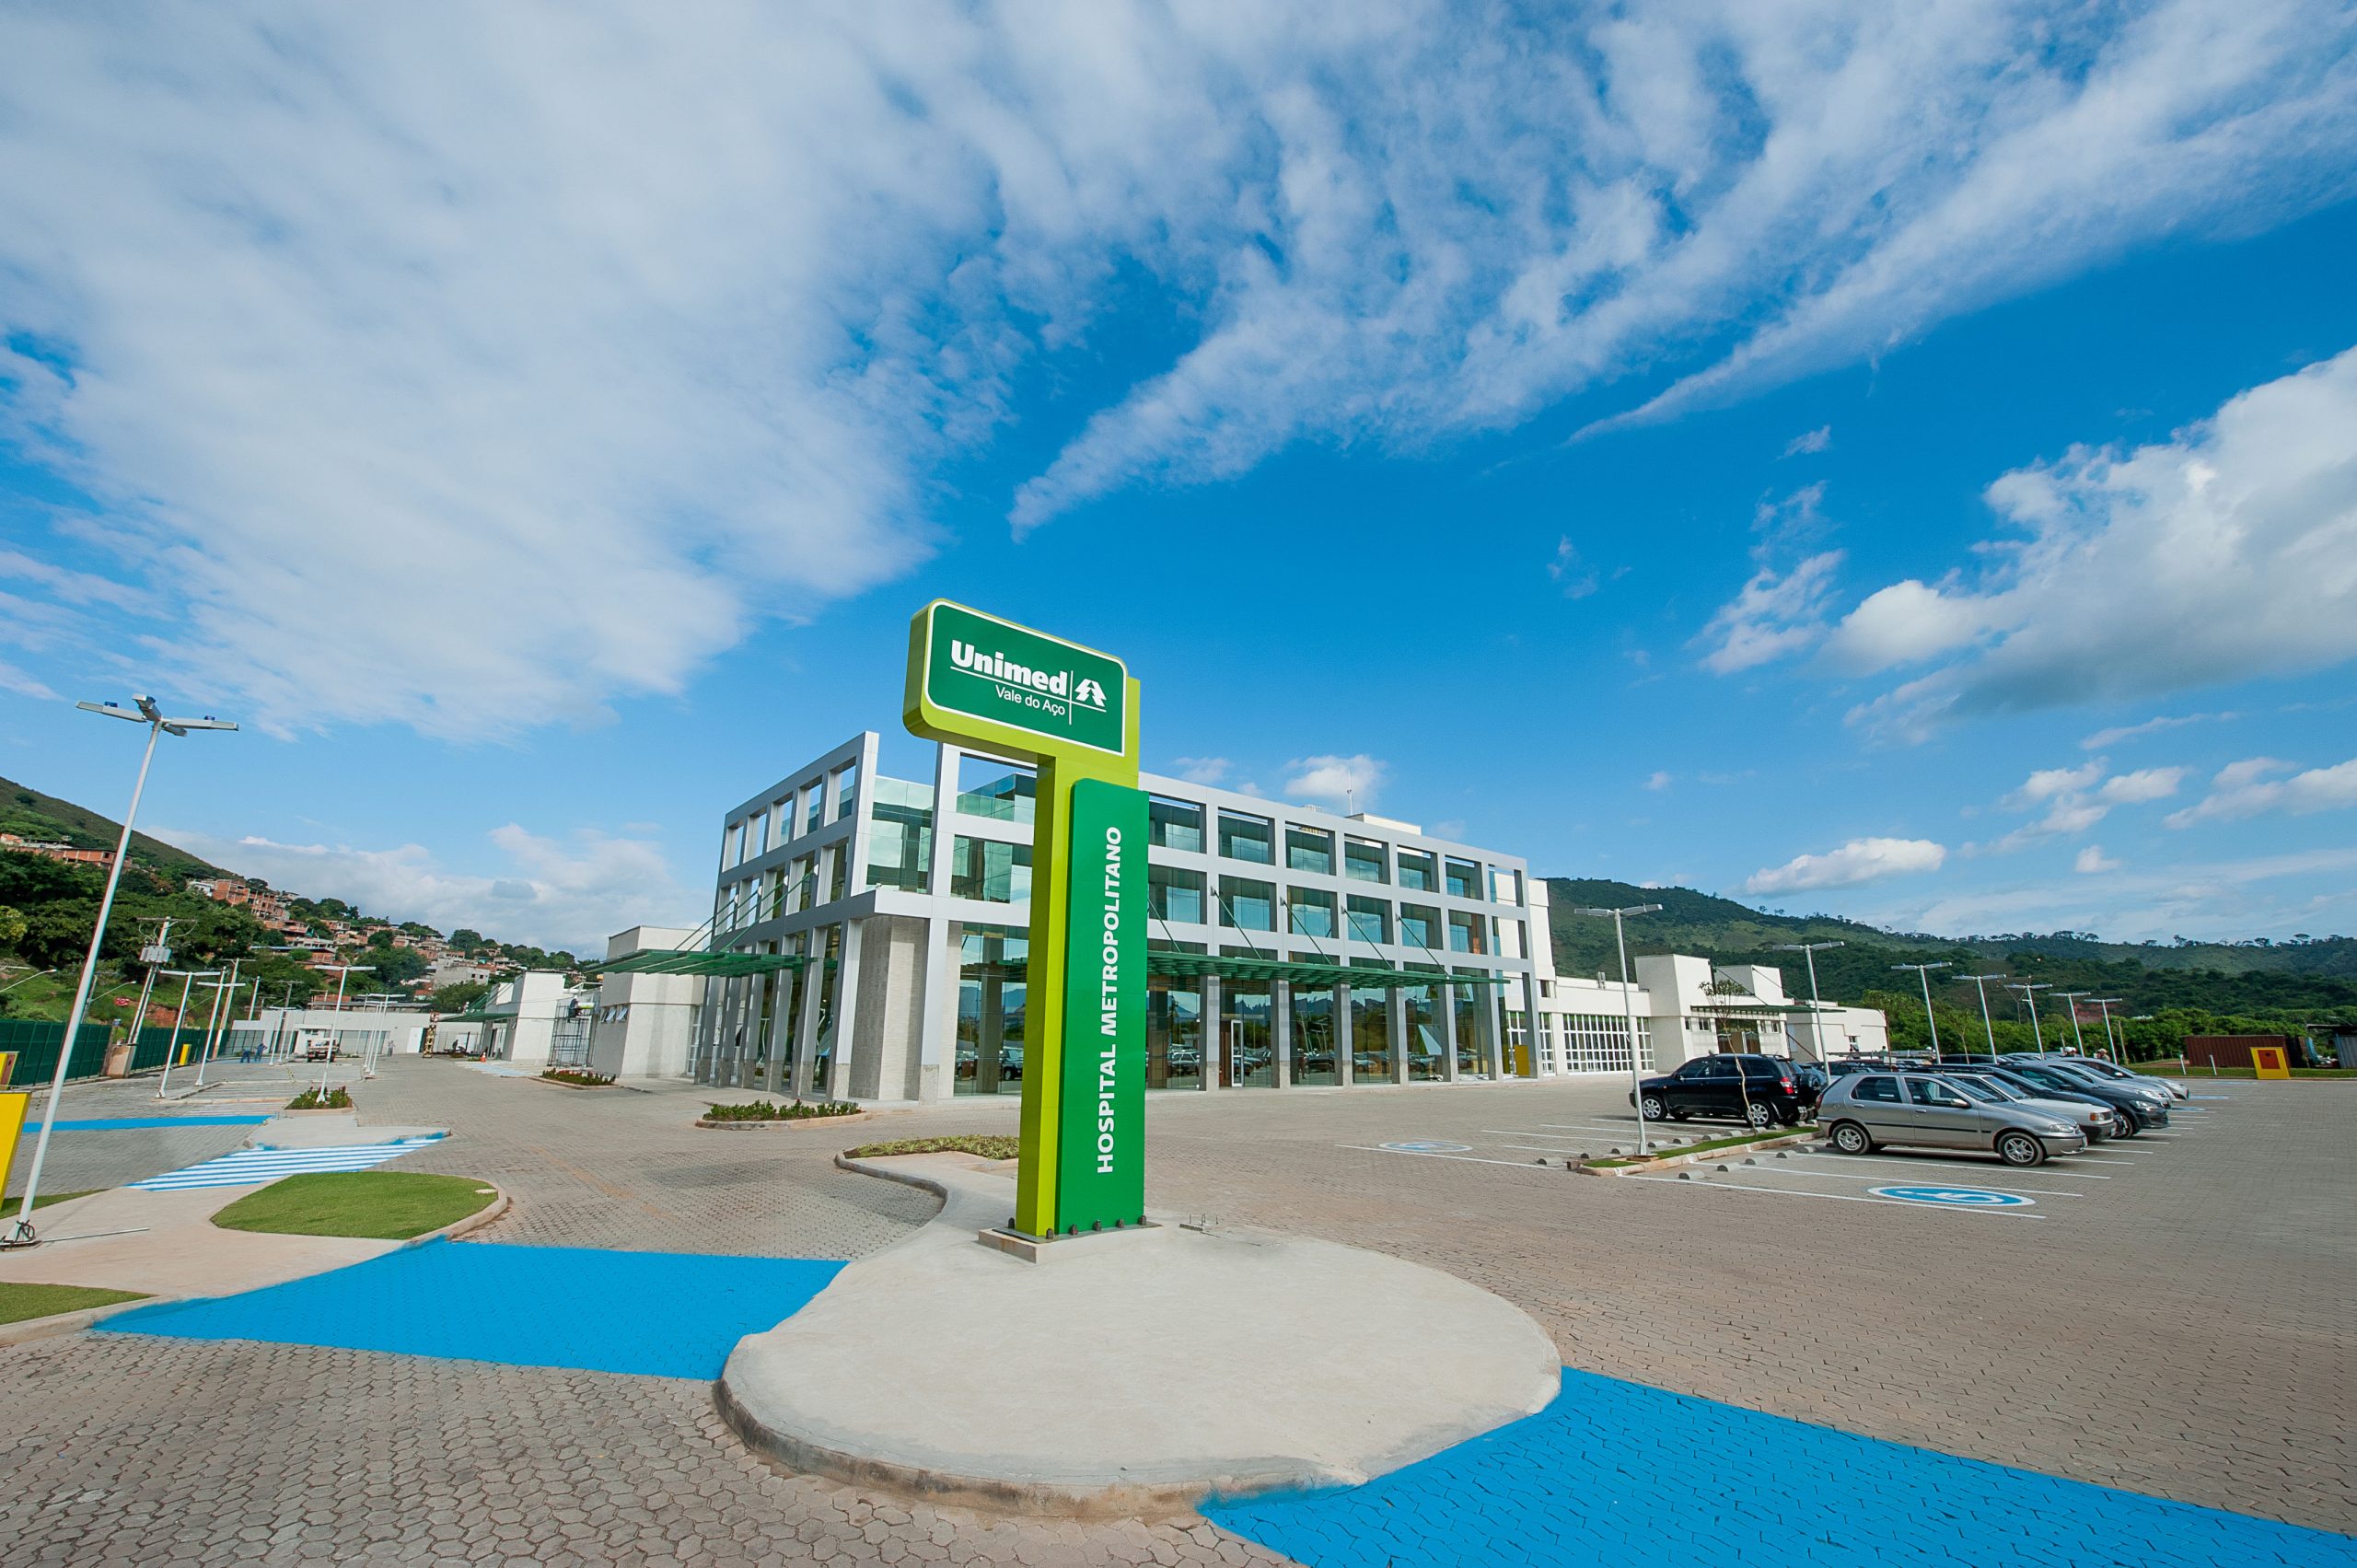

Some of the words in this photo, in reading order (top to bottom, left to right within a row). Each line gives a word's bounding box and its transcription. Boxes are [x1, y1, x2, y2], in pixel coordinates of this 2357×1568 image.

[951, 639, 1068, 696] Unimed
[995, 684, 1022, 704] Vale
[1025, 694, 1040, 709] do
[1042, 700, 1066, 716] Aço
[1100, 826, 1121, 1037] METROPOLITANO
[1097, 1043, 1116, 1173] HOSPITAL
